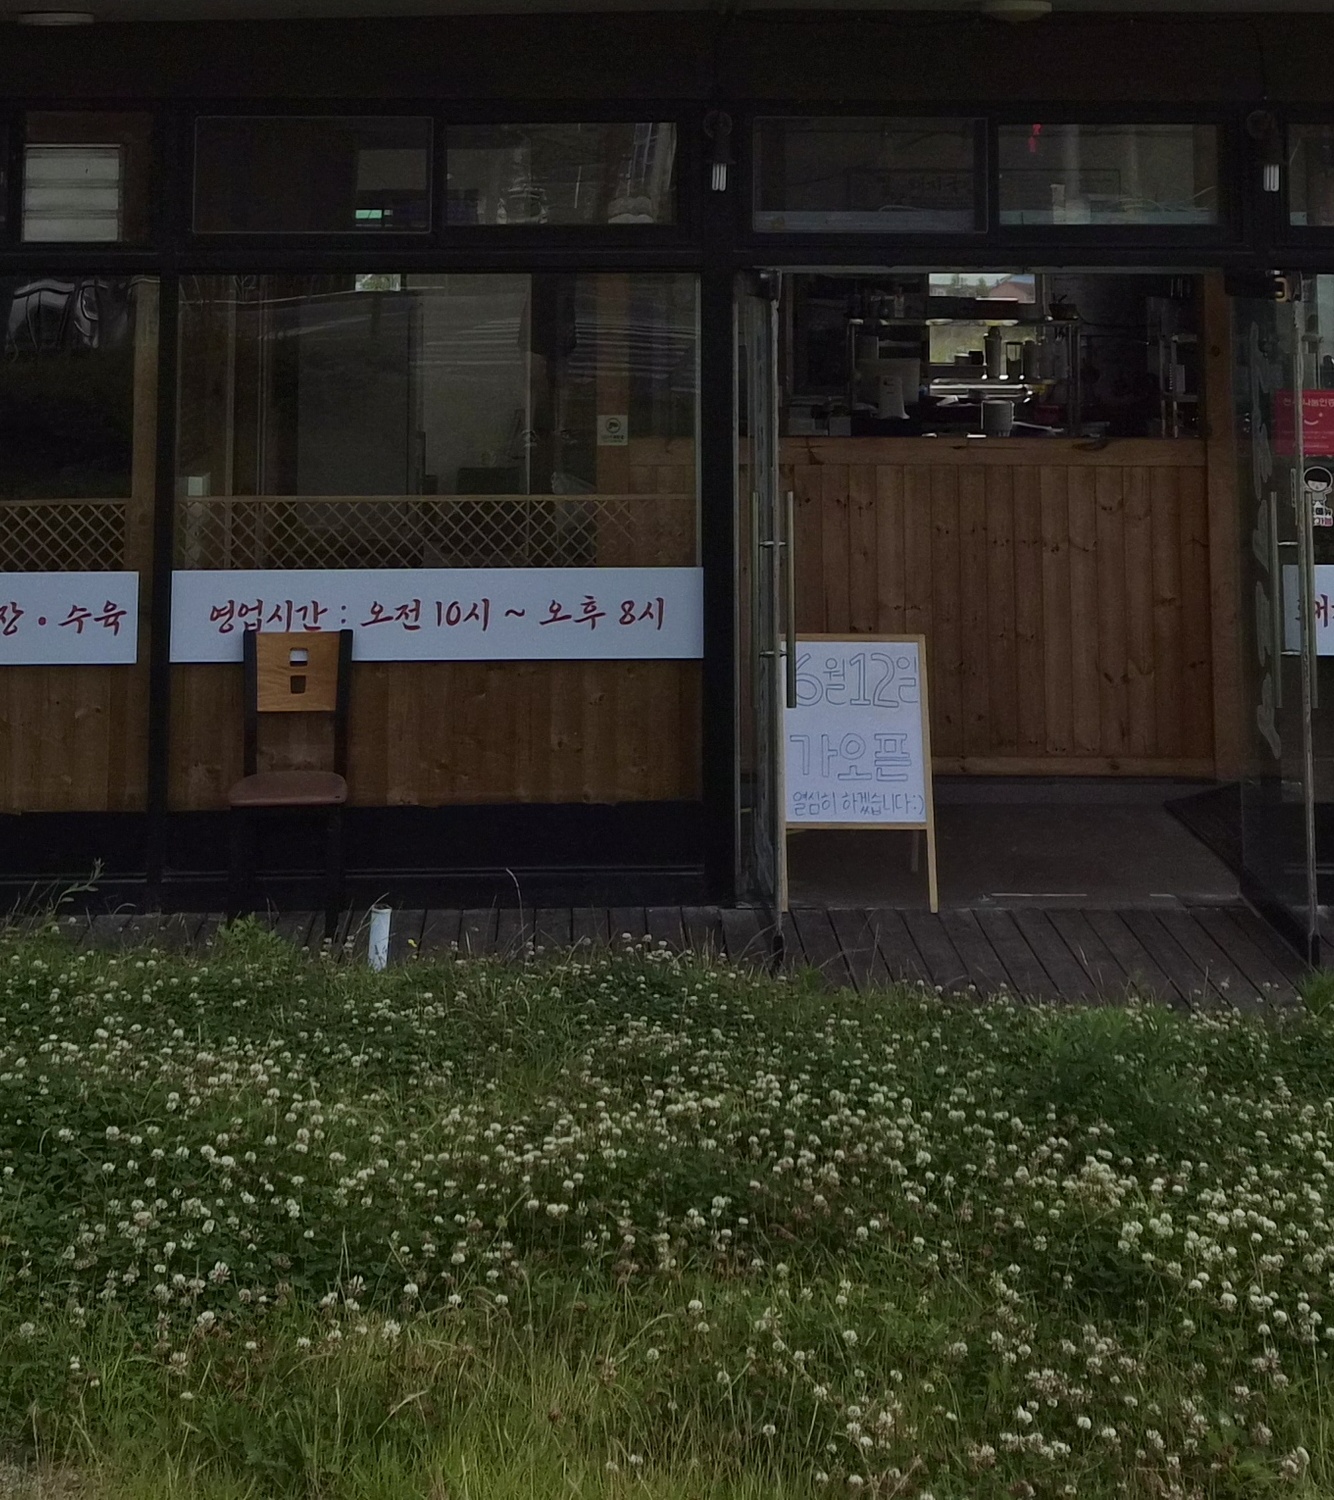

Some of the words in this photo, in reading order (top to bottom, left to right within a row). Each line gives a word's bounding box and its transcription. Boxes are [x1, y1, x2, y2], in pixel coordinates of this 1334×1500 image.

[58, 600, 127, 636] 수육
[361, 599, 421, 630] 오전
[436, 598, 490, 631] 10시
[539, 595, 606, 630] 오후
[619, 597, 665, 630] 8시
[790, 733, 912, 782] 가오픈
[793, 791, 837, 816] 열심히
